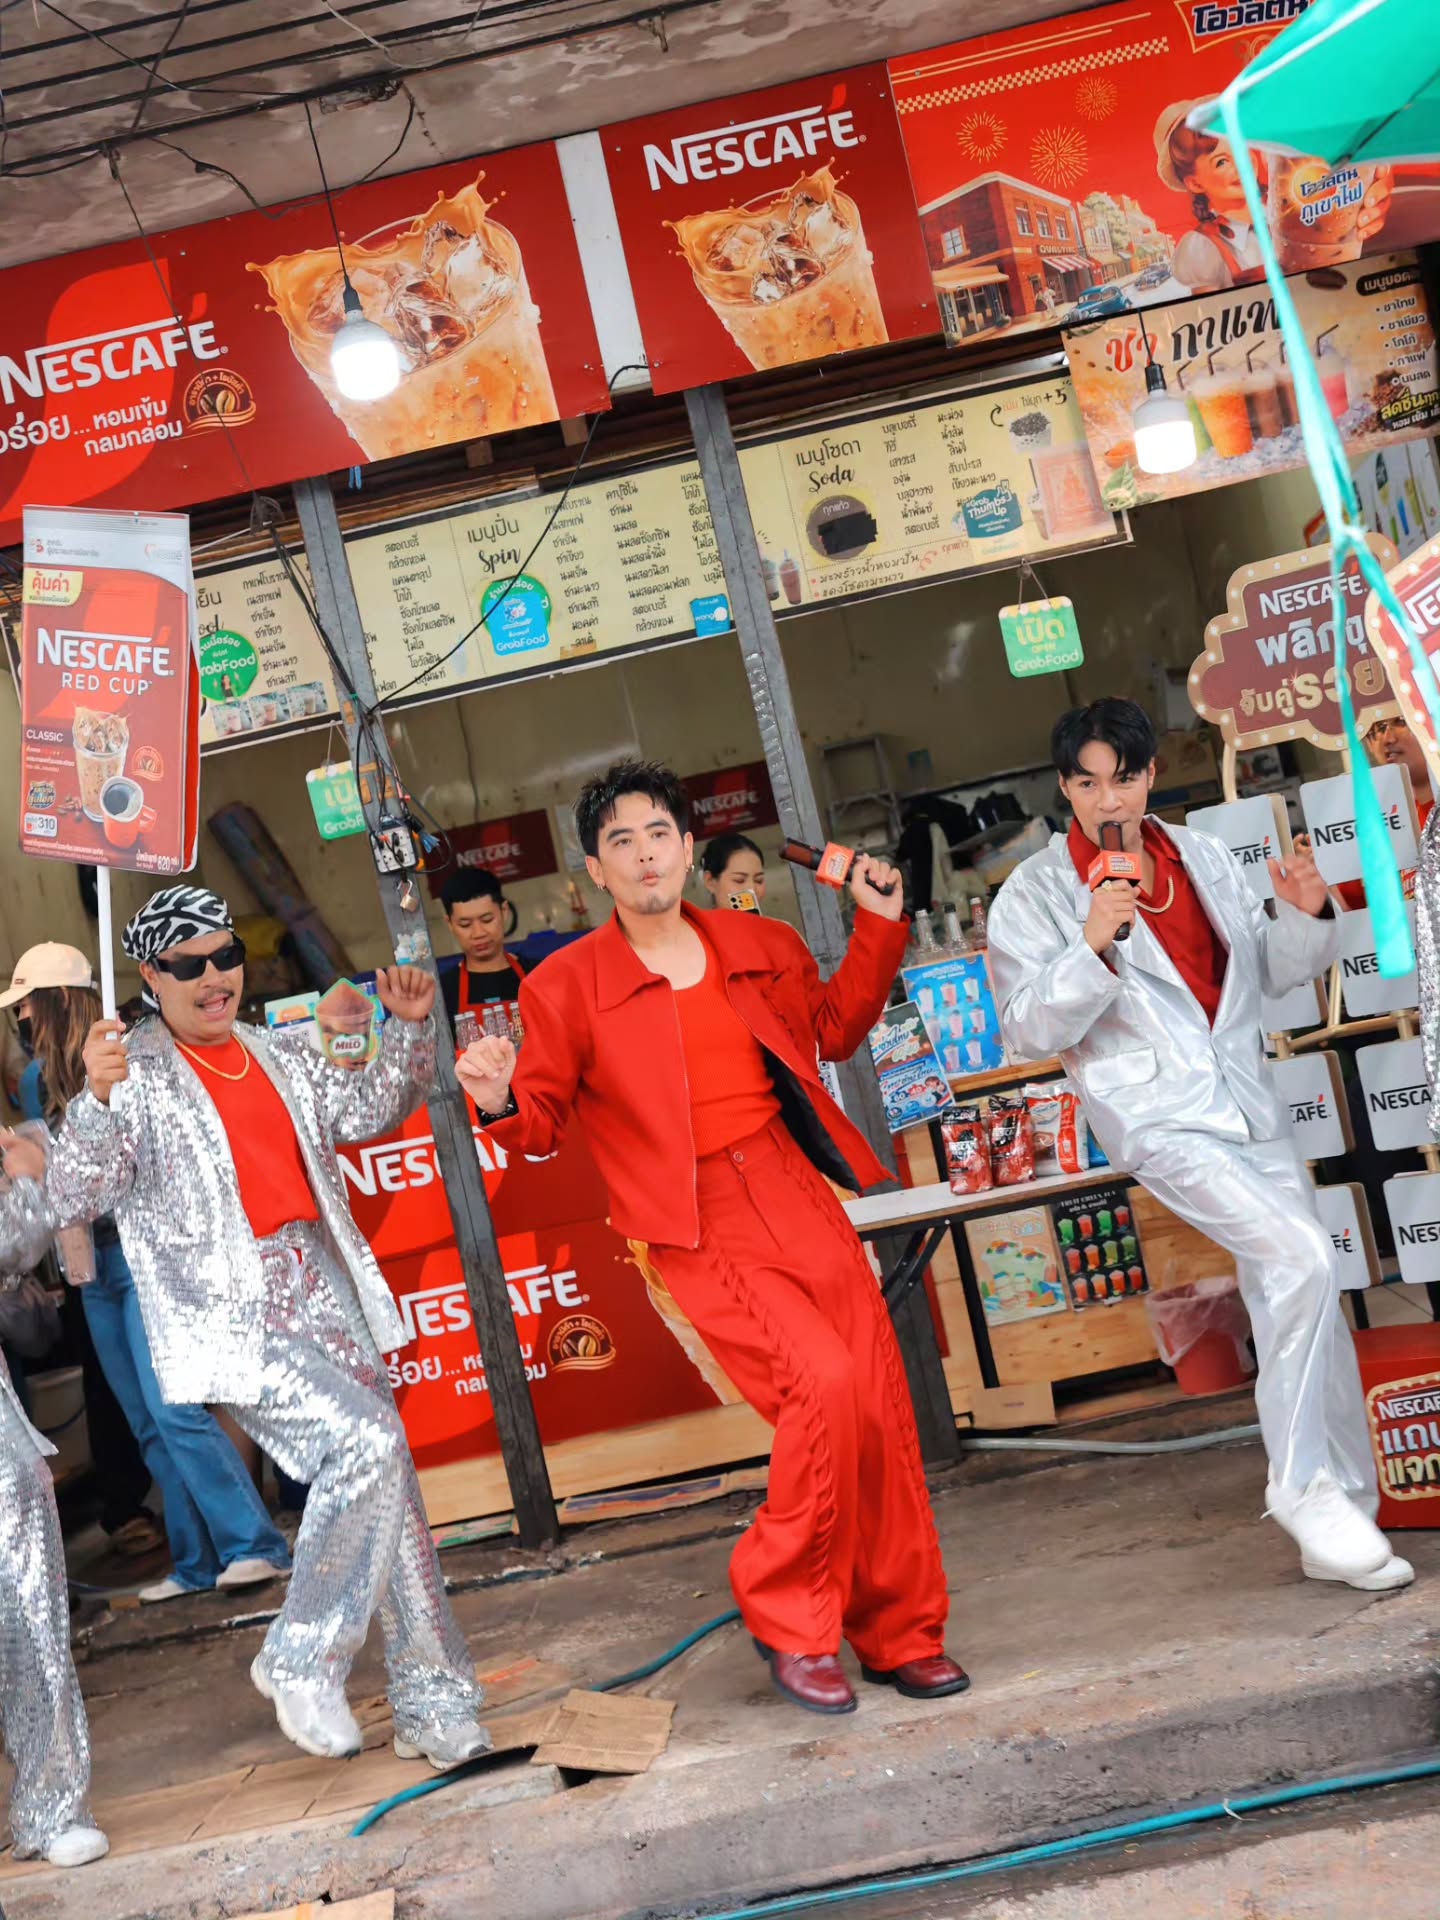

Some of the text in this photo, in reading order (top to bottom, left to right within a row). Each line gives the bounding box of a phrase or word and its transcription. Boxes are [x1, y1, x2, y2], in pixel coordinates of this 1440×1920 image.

[1301, 182, 1363, 226] ภูเขาไฟ
[1384, 297, 1415, 312] ชาไทย
[1388, 313, 1426, 331] ชาเขียว
[1392, 334, 1417, 348] โกโก้
[1397, 350, 1426, 367] กาแฟ
[1401, 371, 1431, 385] นมสด
[93, 396, 168, 431] หอมเข้ม
[938, 406, 964, 422] มะม่วง
[84, 418, 183, 456] กลมกล่อม
[796, 438, 861, 466] เมนูโซดา
[809, 465, 855, 494] Soda
[893, 472, 911, 488] องุ่น
[823, 500, 851, 516] ทุกแก้ว
[467, 513, 520, 543] เมนูปั่น
[479, 548, 521, 573] Spin
[32, 571, 70, 595] คุ้มค่า
[1016, 617, 1065, 645] เปิด
[496, 634, 546, 651] GrabFood
[200, 653, 256, 676] rabFood
[1014, 649, 1079, 672] GrabFood
[62, 672, 149, 695] RED CUP
[26, 729, 64, 743] CLASSIC
[39, 816, 56, 831] 310
[324, 815, 363, 834] GrabF
[335, 1040, 361, 1051] MILO
[1370, 1084, 1431, 1112] NESCA
